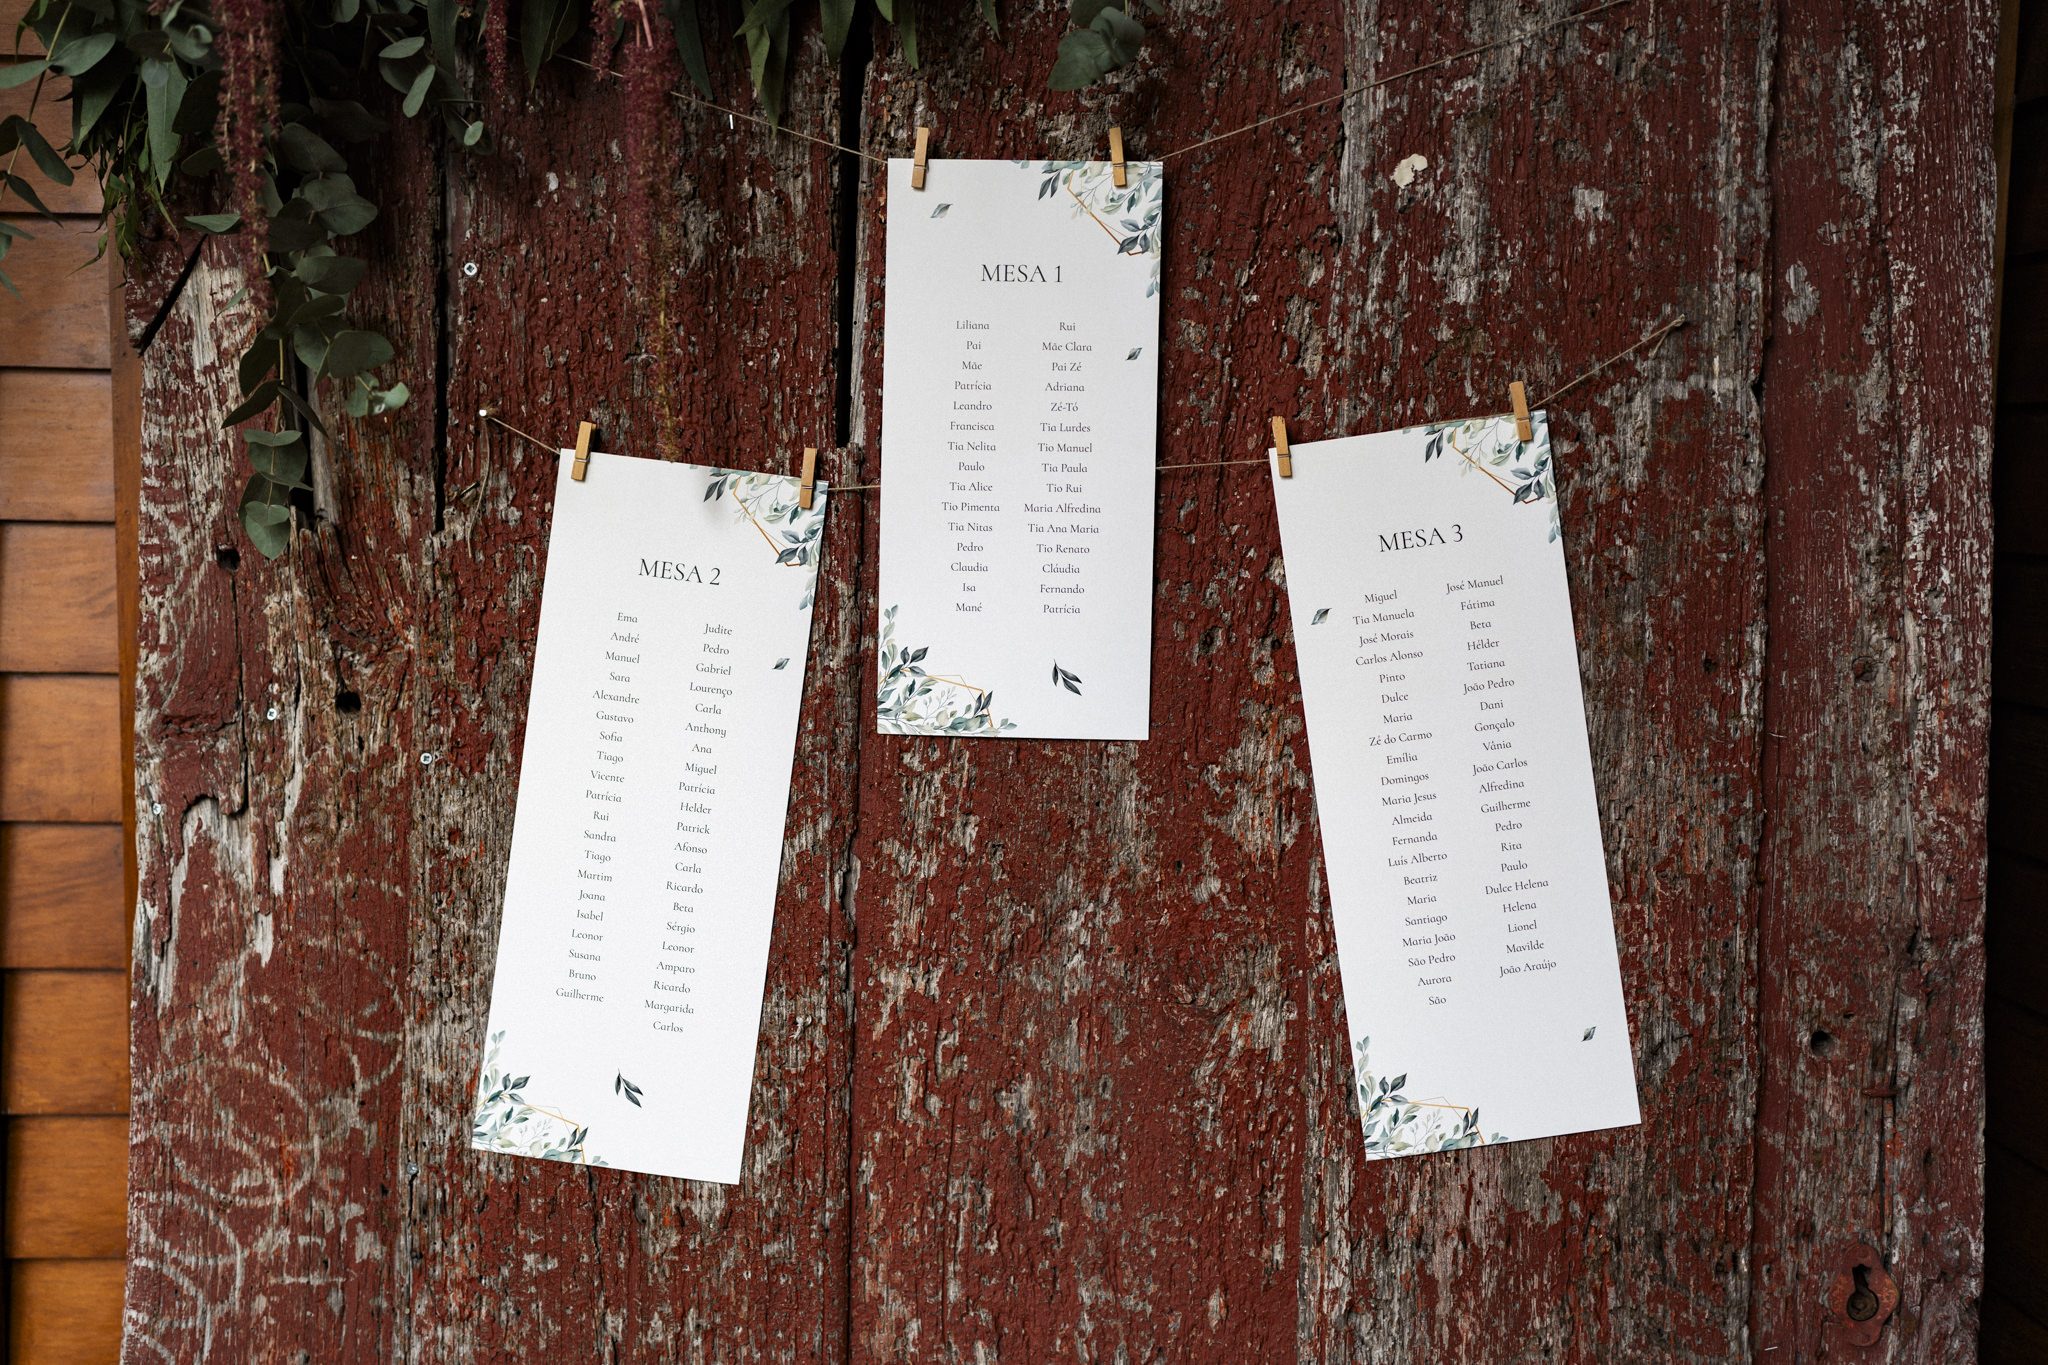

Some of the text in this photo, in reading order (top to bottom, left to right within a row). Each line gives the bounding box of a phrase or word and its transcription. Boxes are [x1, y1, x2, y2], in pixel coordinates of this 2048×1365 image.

[980, 263, 1063, 284] MESA 1
[956, 319, 990, 330] Liliana
[1059, 321, 1076, 332] Rui
[966, 340, 982, 351] Pai
[1041, 340, 1093, 352] Mãe Clara
[961, 360, 983, 371] Mãe
[1051, 361, 1083, 372] Pai Zé
[954, 379, 992, 391] Patrícia
[1044, 380, 1085, 392] Adriana
[953, 400, 993, 411] Leandro
[1050, 401, 1079, 413] Zé-Tó
[950, 420, 995, 431] Francisca
[1039, 421, 1091, 433] Tia Lurdes
[947, 440, 997, 452] Tia Nelita
[1037, 442, 1093, 453] Tio Manuel
[958, 460, 986, 472] Paulo
[1041, 462, 1088, 473] Tia Paula
[948, 481, 993, 492] Tia Alice
[1045, 482, 1083, 494] Tio Rui
[941, 501, 1001, 512] Tio Pimenta
[1023, 502, 1102, 514] Maria Alfredina
[947, 521, 993, 532] Tia Nitas
[1027, 523, 1100, 534] Tia Ana Maria
[1377, 523, 1464, 553] MESA 3
[956, 541, 984, 552] Pedro
[1035, 543, 1091, 554] Tio Renato
[637, 557, 721, 586] MESA 2
[950, 561, 989, 573] Claudia
[1041, 562, 1081, 574] Cláudia
[962, 582, 977, 593] Isa
[1040, 583, 1085, 595] Fernando
[1445, 574, 1504, 596] José Manuel
[1364, 588, 1398, 605] Miguel
[955, 601, 983, 613] Mané
[1043, 603, 1081, 615] Patrícia
[1460, 599, 1496, 611] Fátima
[617, 611, 638, 624] Ema
[1352, 608, 1415, 626] Tia Manuela
[702, 623, 733, 636] Judite
[1469, 620, 1492, 631] Beta
[610, 631, 640, 644] André
[1358, 629, 1415, 649] José Morais
[702, 643, 730, 656] Pedro
[1466, 637, 1500, 652] Hélder
[604, 650, 641, 664] Manuel
[1355, 650, 1424, 666] Carlos Alonso
[695, 662, 732, 676] Gabriel
[1466, 660, 1506, 672] Tatiana
[609, 671, 631, 683] Sara
[1378, 673, 1406, 684] Pinto
[689, 681, 733, 699] Lourenço
[1462, 677, 1515, 696] João Pedro
[592, 689, 640, 705] Alexandre
[1381, 691, 1409, 704] Dulce
[694, 702, 722, 715] Carla
[1479, 699, 1504, 711] Dani
[595, 710, 635, 724] Gustavo
[1382, 712, 1414, 725] Maria
[684, 722, 727, 739] Anthony
[1473, 717, 1516, 733] Gonçalo
[599, 730, 623, 743] Sofia
[1368, 731, 1433, 747] Zé do Carmo
[691, 743, 712, 754] Ana
[596, 750, 624, 765] Tiago
[1385, 751, 1419, 765] Emília
[684, 761, 718, 777] Miguel
[1472, 757, 1529, 777] João Carlos
[590, 769, 625, 783] Vicente
[1380, 773, 1430, 787] Domingos
[678, 781, 716, 795] Patrícia
[1478, 779, 1525, 794] Alfredina
[585, 789, 622, 803] Patrícia
[1381, 792, 1438, 807] Maria Jesus
[680, 801, 713, 815] Helder
[1480, 800, 1532, 814] Guilherme
[593, 810, 610, 822] Rui
[1391, 810, 1433, 826] Almeida
[676, 821, 711, 835] Patrick
[1494, 819, 1523, 833] Pedro
[583, 829, 617, 843] Sandra
[1391, 830, 1438, 846] Fernanda
[673, 841, 708, 855] Afonso
[1500, 841, 1523, 852] Rita
[584, 849, 612, 865] Tiago
[1387, 852, 1448, 868] Luís Alberto
[674, 861, 702, 874] Carla
[1500, 859, 1529, 873] Paulo
[577, 868, 613, 883] Martim
[1403, 873, 1439, 886] Beatriz
[665, 880, 704, 895] Ricardo
[1484, 878, 1549, 895] Dulce Helena
[577, 889, 606, 902] Joana
[1406, 893, 1438, 906] Maria
[672, 901, 694, 913] Beta
[1502, 900, 1537, 914] Helena
[576, 909, 604, 922] Isabel
[1404, 914, 1448, 927] Santiago
[666, 921, 696, 936] Sérgio
[1507, 919, 1538, 934] Lionel
[571, 928, 604, 942] Leonor
[1401, 933, 1457, 948] Maria João
[661, 940, 695, 954] Leonor
[1505, 939, 1545, 954] Mavilde
[568, 948, 601, 962] Susana
[1407, 952, 1456, 968] São Pedro
[568, 968, 597, 981] Bruno
[656, 961, 696, 975] Amparo
[1499, 958, 1557, 979] João Araújo
[653, 980, 691, 994] Ricardo
[1417, 975, 1453, 987] Aurora
[555, 987, 605, 1003] Guilherme
[1428, 995, 1447, 1006] São
[644, 999, 695, 1015] Margarida
[652, 1020, 684, 1033] Carlos
